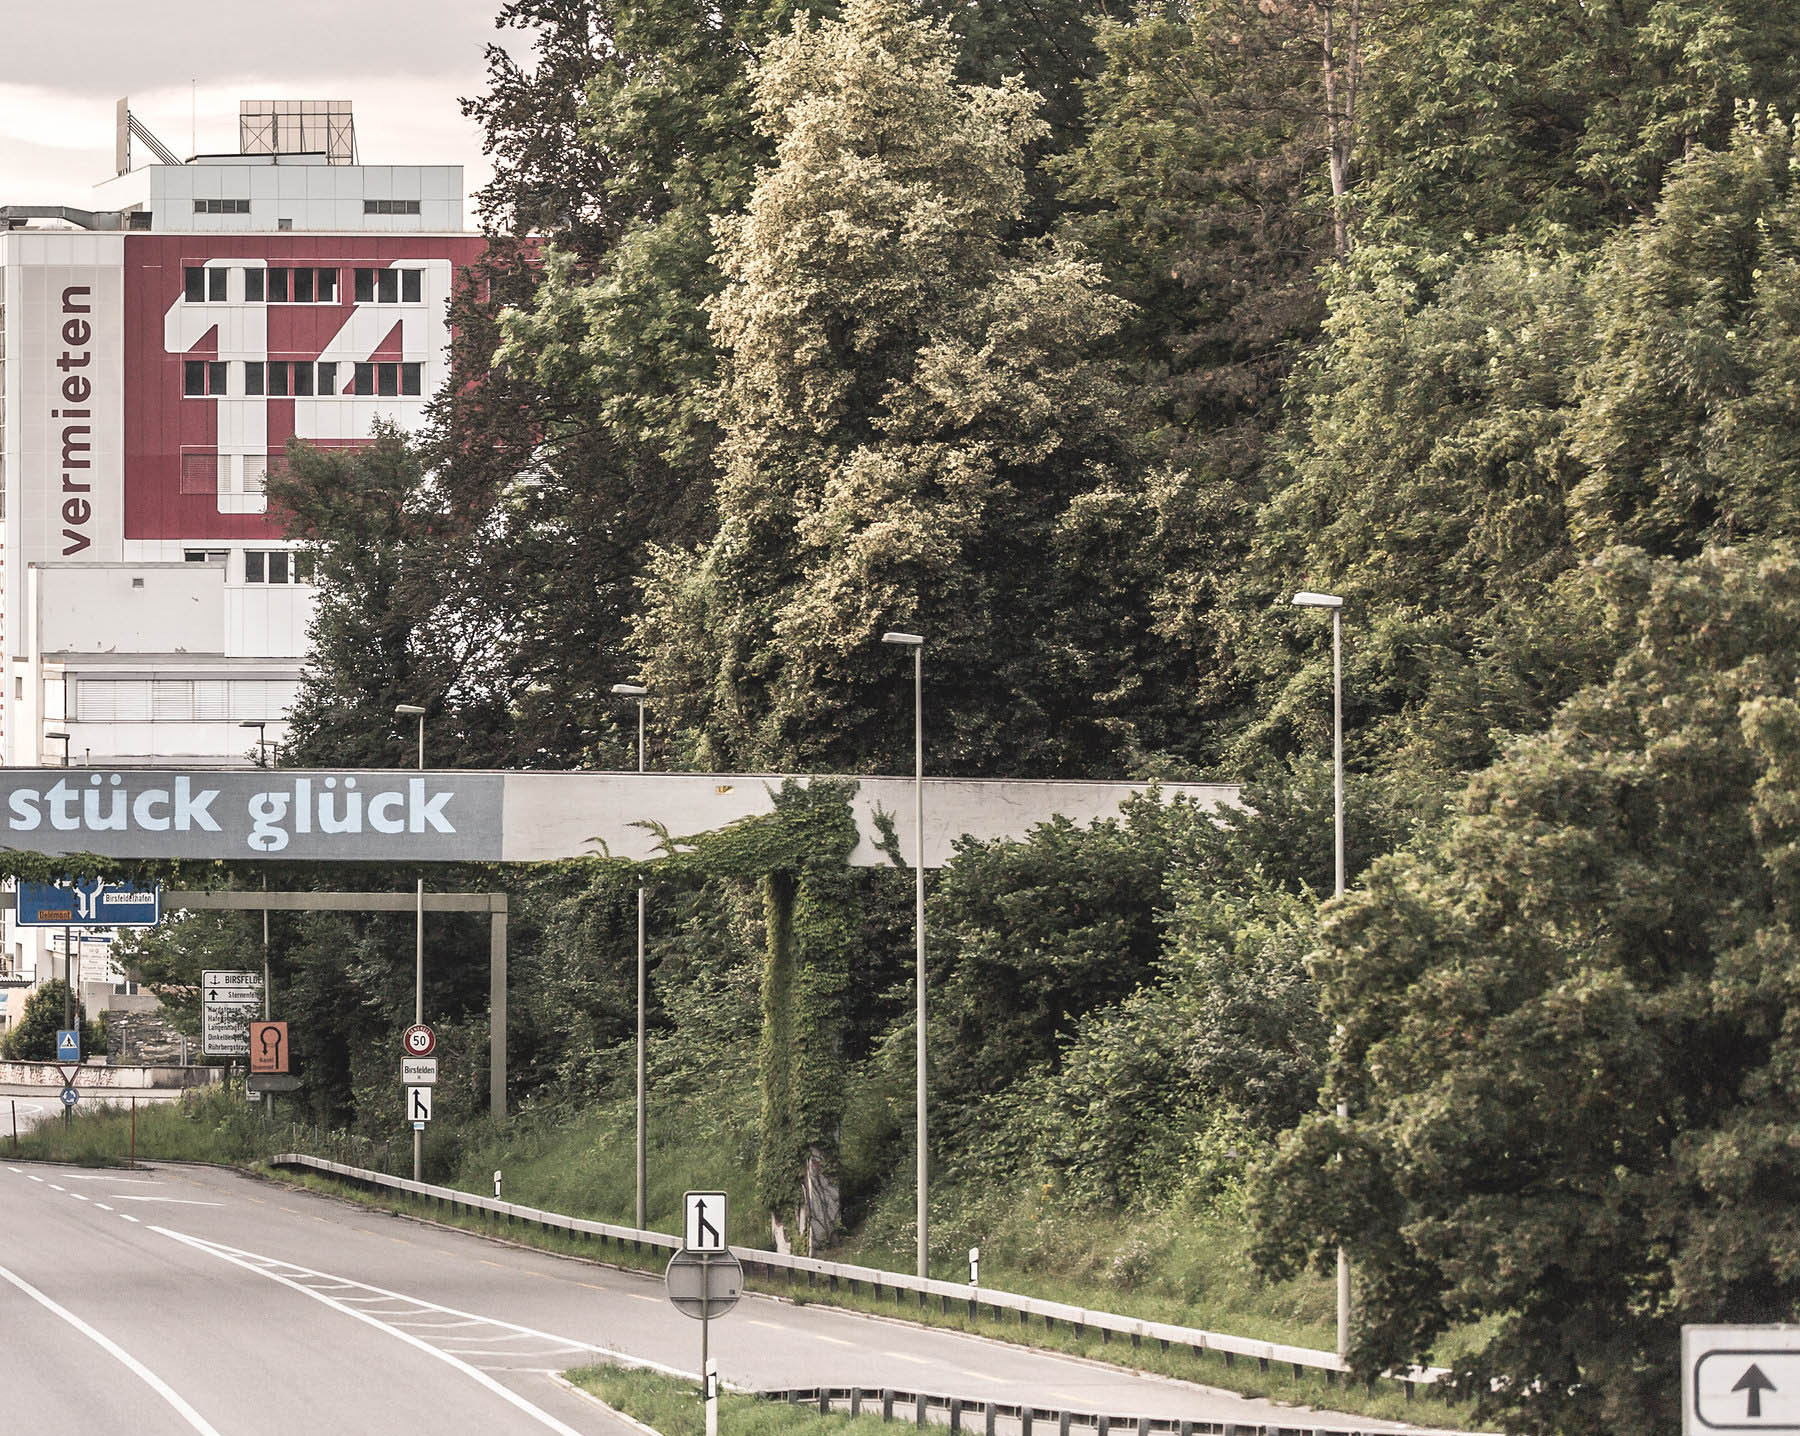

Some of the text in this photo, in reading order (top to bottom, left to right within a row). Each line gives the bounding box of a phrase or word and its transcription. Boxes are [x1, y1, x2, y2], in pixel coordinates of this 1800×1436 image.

[51, 286, 92, 556] vermieten
[164, 259, 452, 515] 14
[9, 774, 222, 832] stück
[247, 777, 457, 852] glück
[404, 1065, 435, 1074] Birsfelden
[413, 1035, 426, 1046] 50
